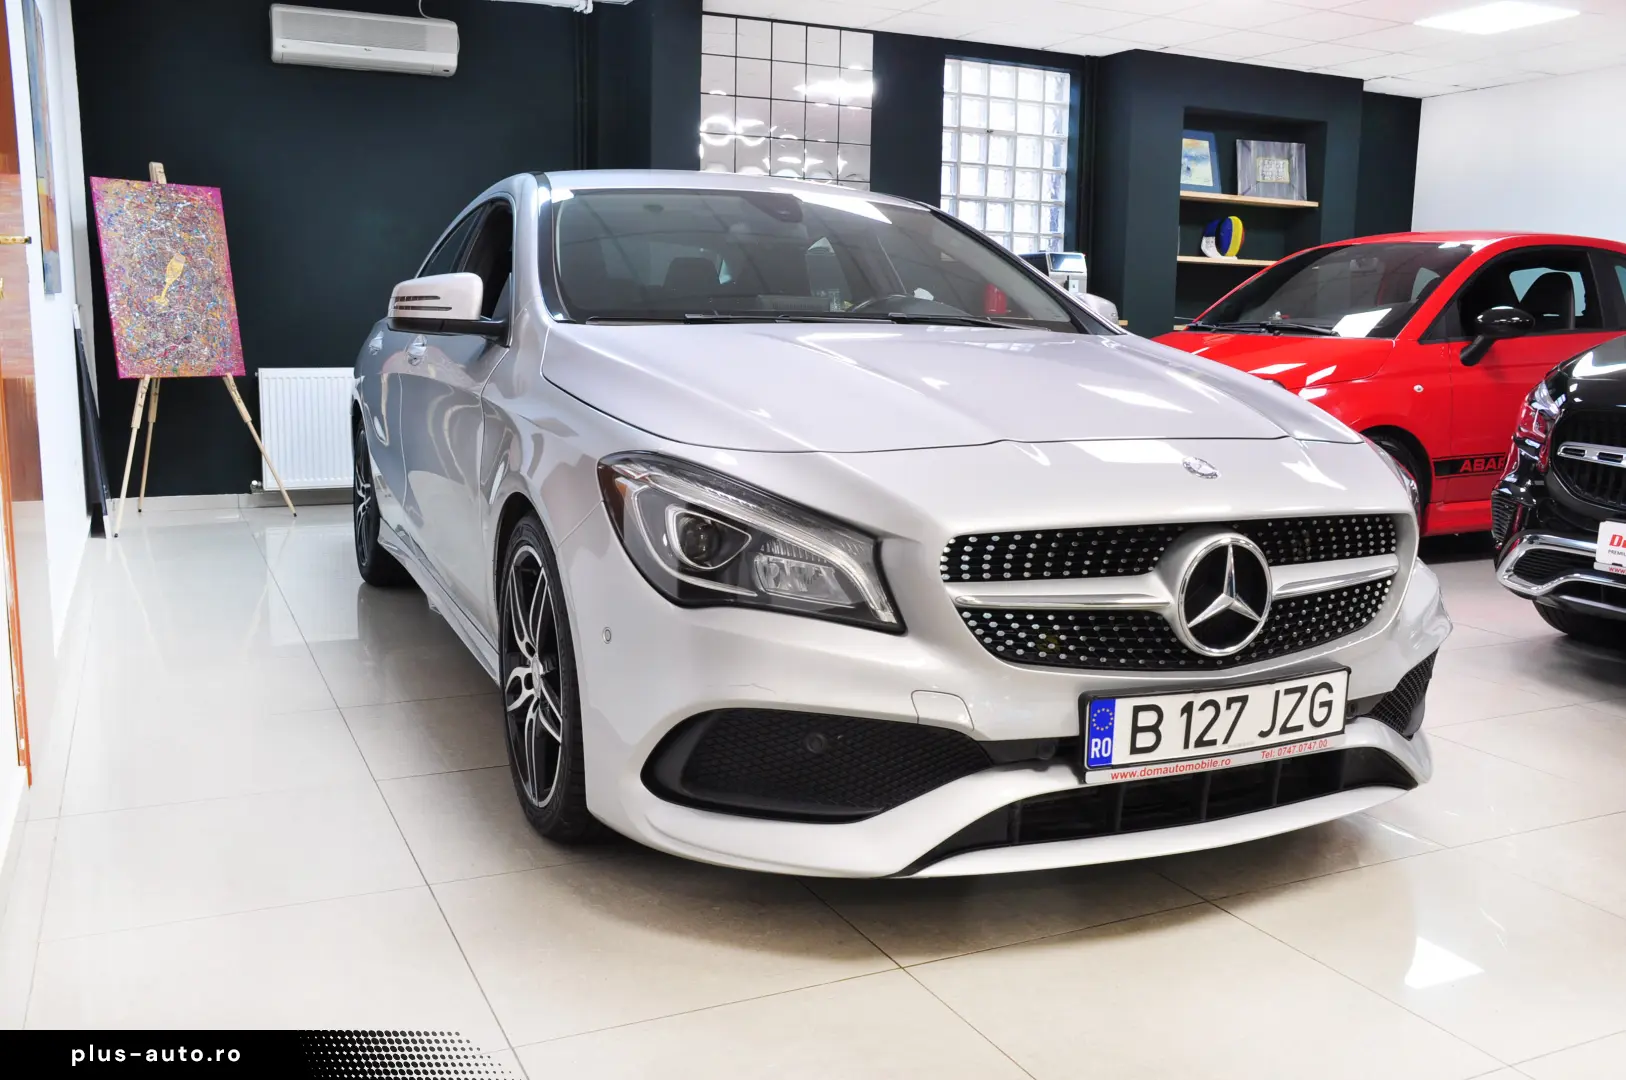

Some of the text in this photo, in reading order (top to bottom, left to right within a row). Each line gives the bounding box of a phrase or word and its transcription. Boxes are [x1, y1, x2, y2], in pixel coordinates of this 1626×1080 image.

[1130, 681, 1334, 755] B 127 JZG
[1090, 736, 1112, 759] RO
[1110, 757, 1231, 780] www.domautomobile.ro
